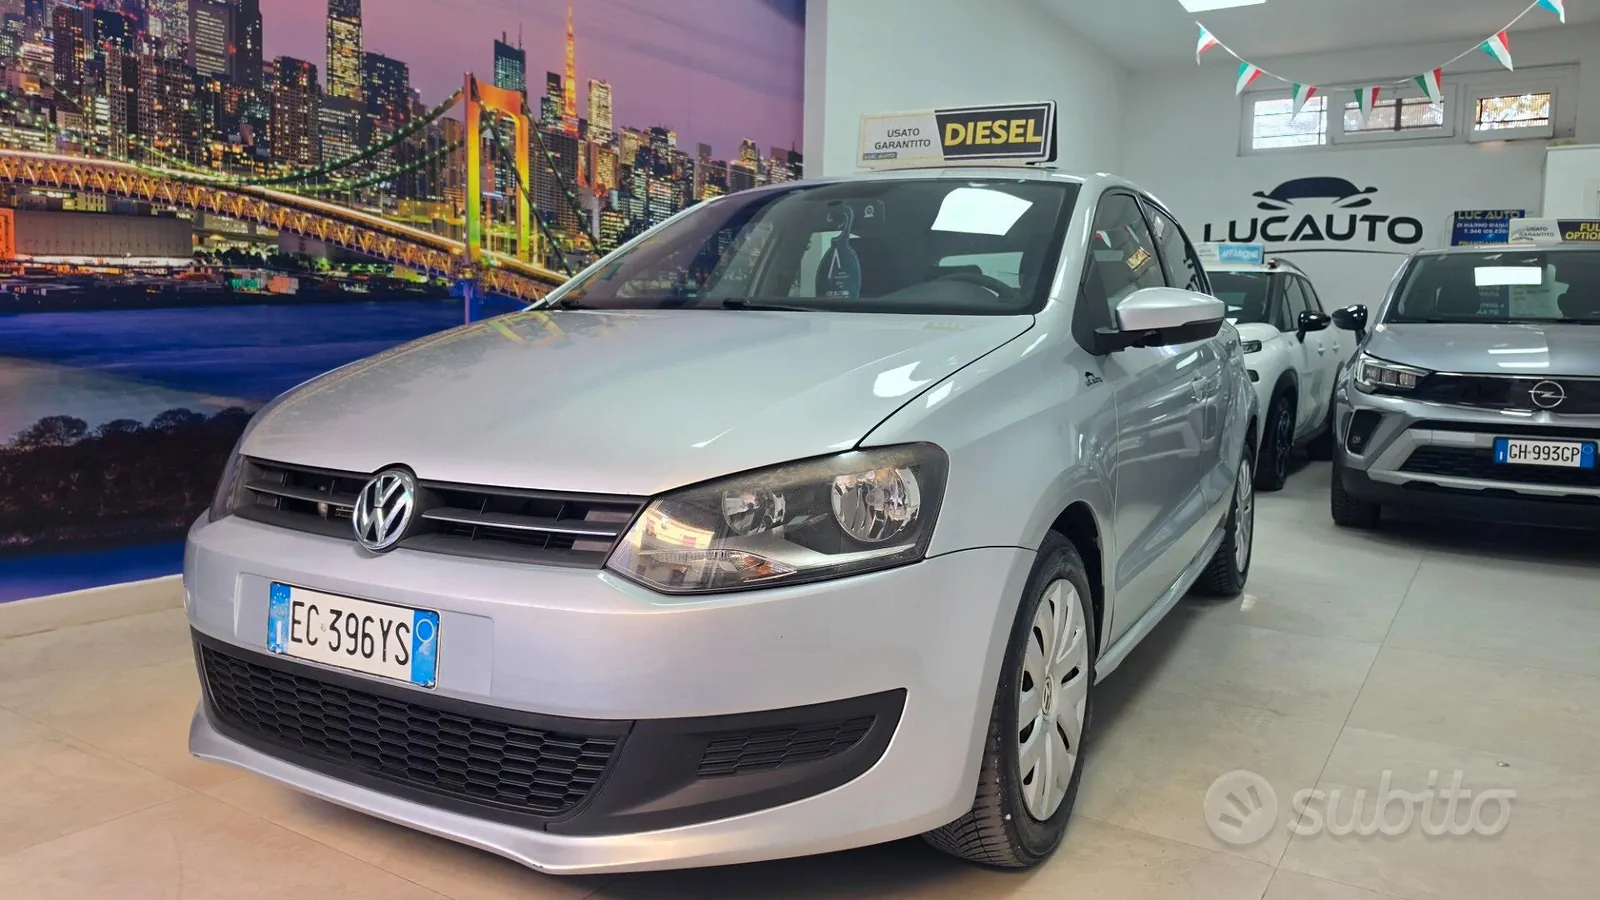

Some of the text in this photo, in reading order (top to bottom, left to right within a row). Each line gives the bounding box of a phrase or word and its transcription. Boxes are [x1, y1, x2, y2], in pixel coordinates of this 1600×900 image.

[887, 128, 920, 138] USATO
[943, 118, 1043, 147] DIESEL
[874, 139, 931, 150] GARANTITO
[1458, 210, 1521, 220] LUC AUTO
[1203, 214, 1424, 244] LUCAUTO
